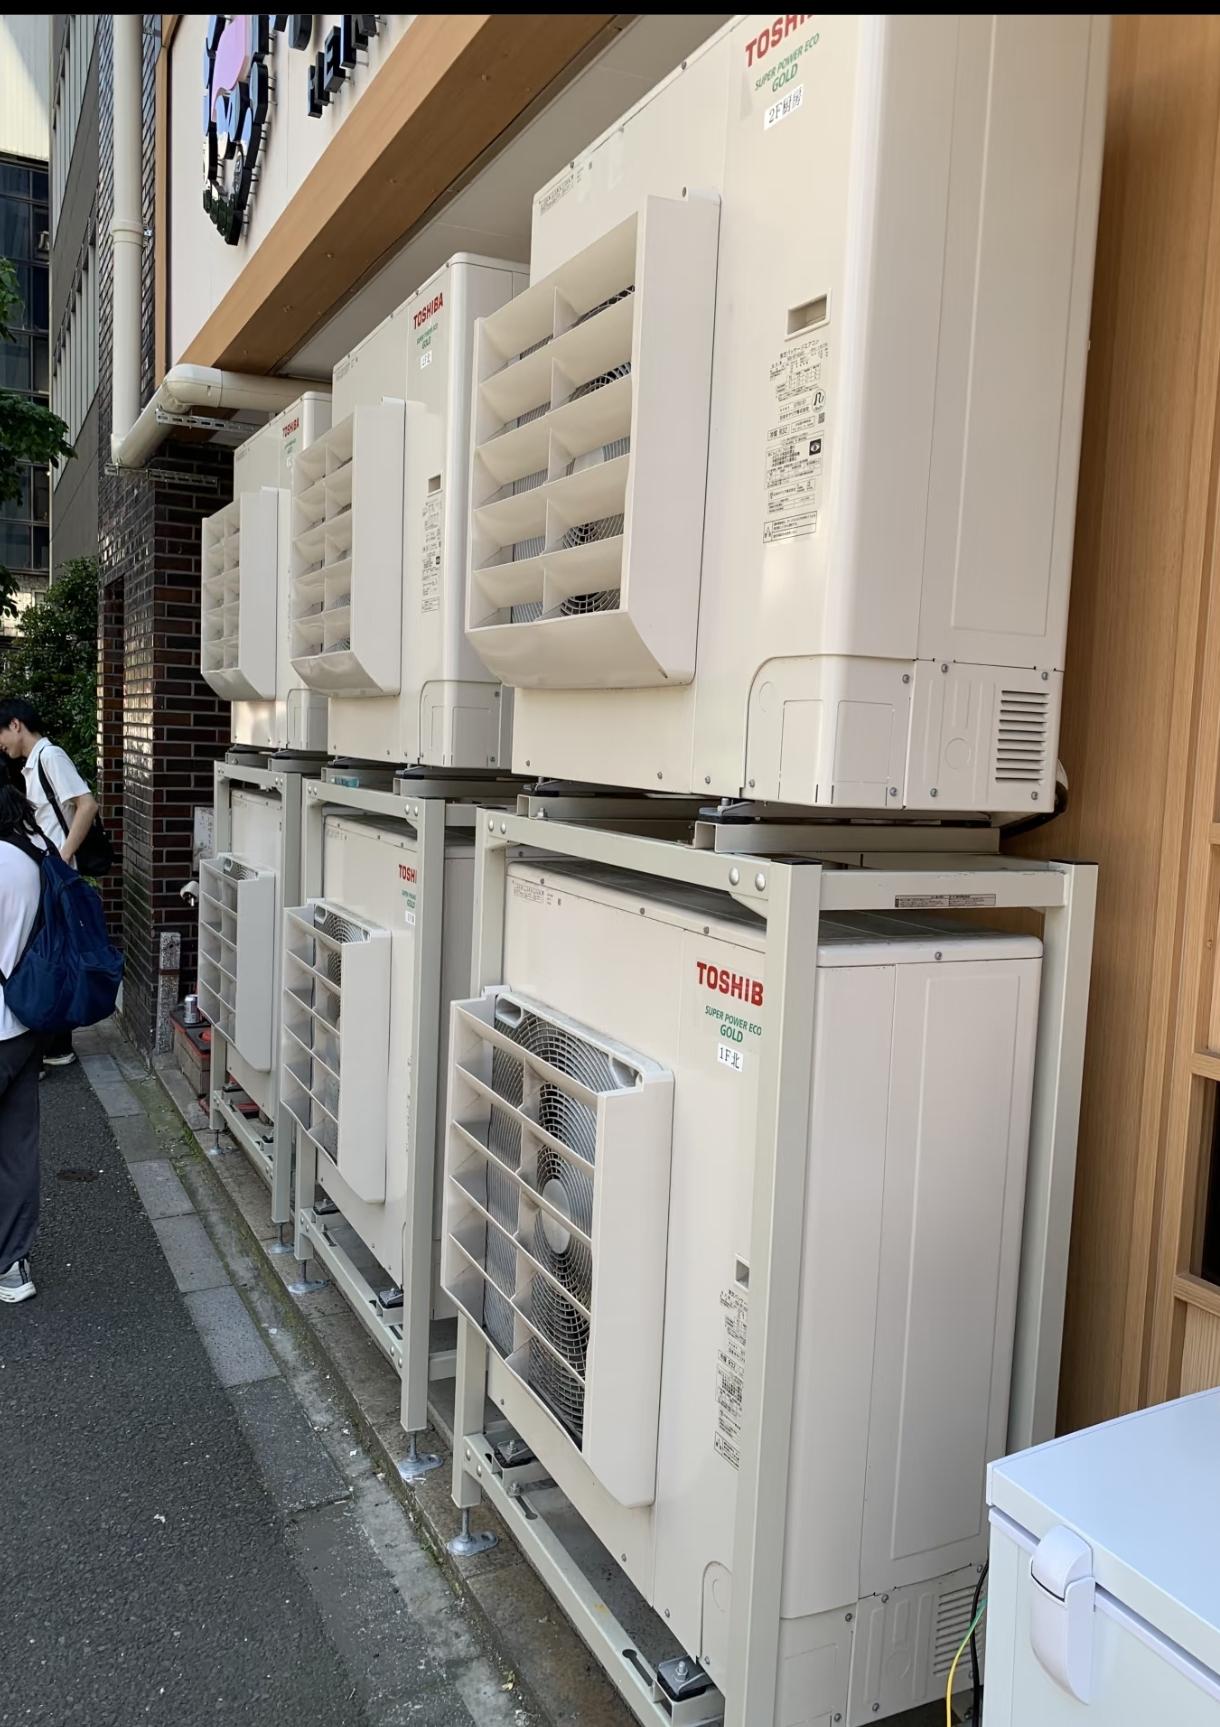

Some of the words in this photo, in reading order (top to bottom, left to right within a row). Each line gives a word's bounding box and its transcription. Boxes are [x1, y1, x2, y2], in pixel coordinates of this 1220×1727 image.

[755, 66, 776, 91] SUPER
[777, 45, 803, 74] POWER
[804, 32, 820, 53] ECO
[772, 63, 798, 92] GOLD
[413, 292, 443, 330] TOSHIBA
[282, 417, 299, 438] TOSHIBA
[696, 961, 764, 1006] TOSHIB
[705, 1005, 724, 1020] SUPER
[724, 1013, 748, 1030] POWER
[748, 1023, 762, 1036] ECO
[720, 1024, 743, 1043] GOLD
